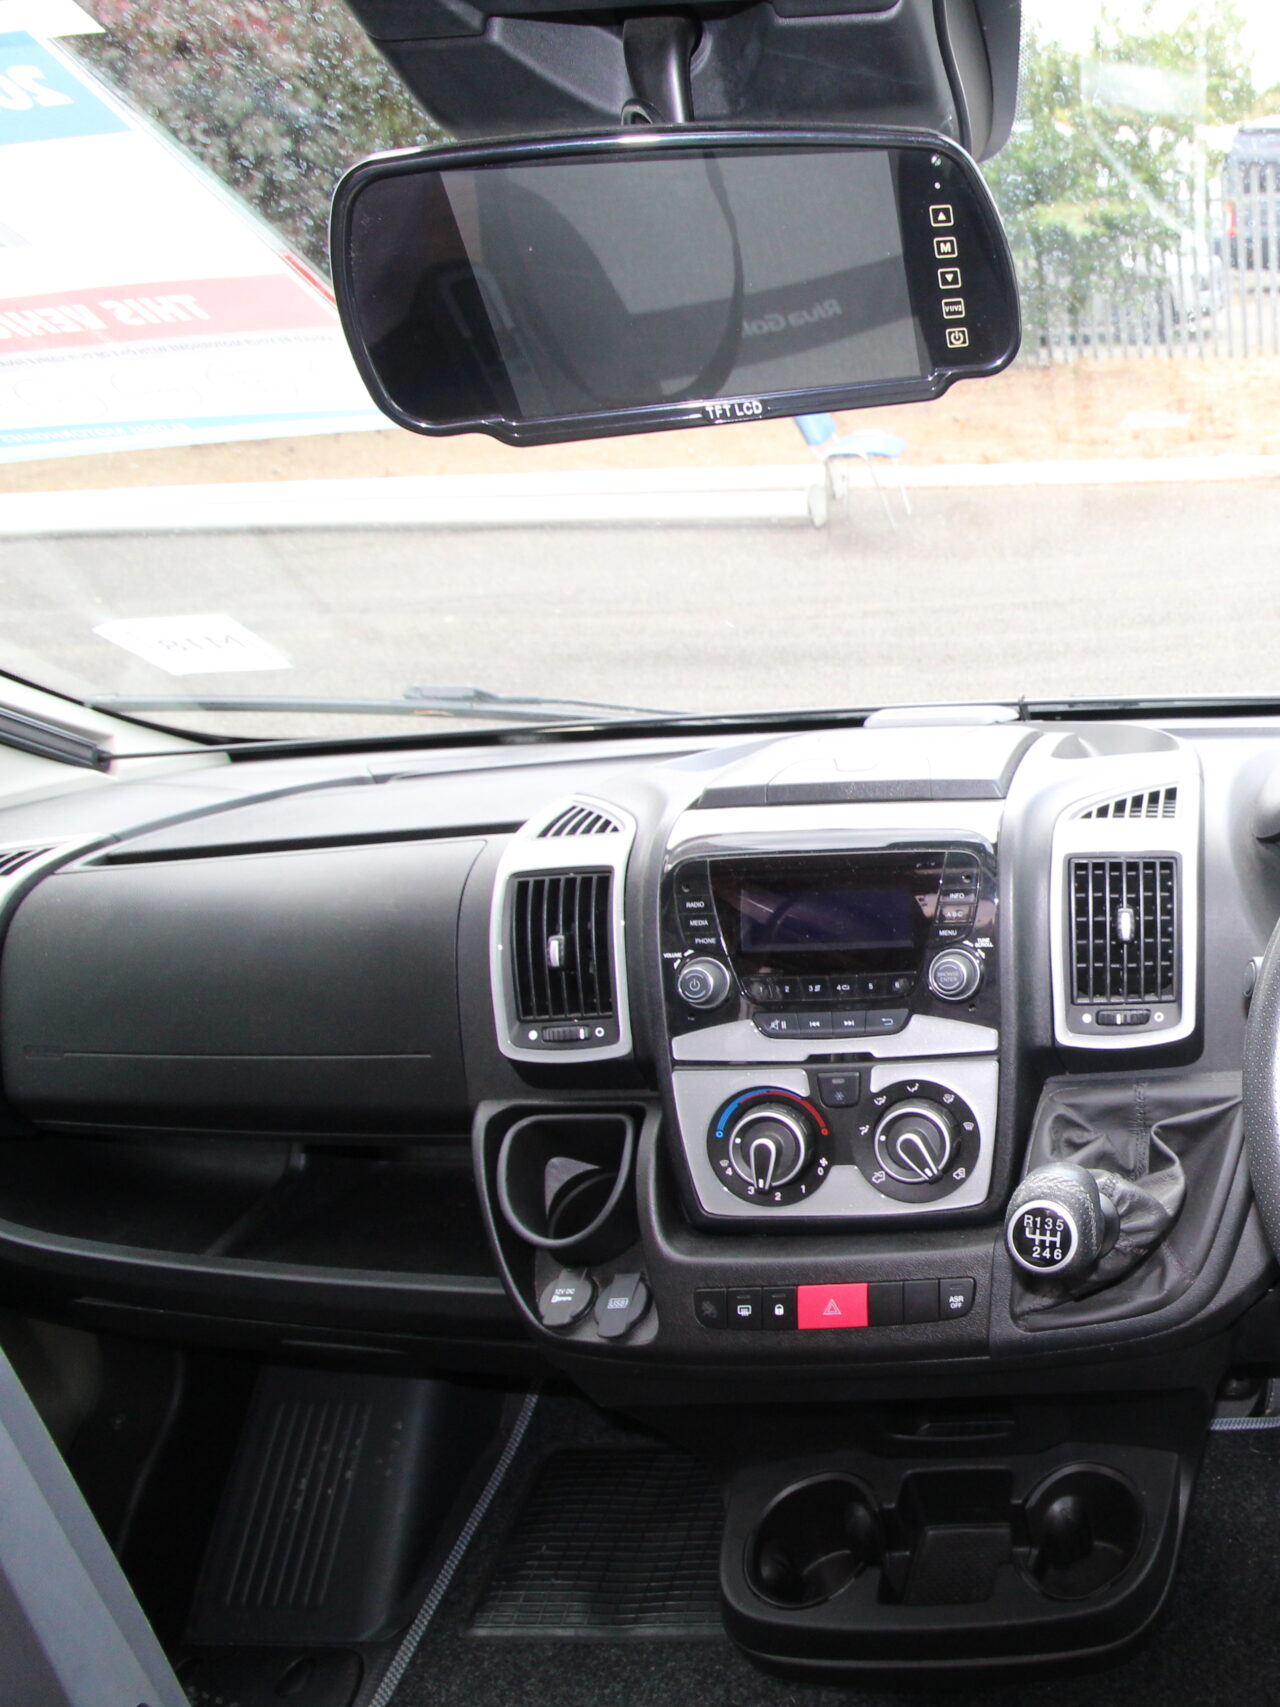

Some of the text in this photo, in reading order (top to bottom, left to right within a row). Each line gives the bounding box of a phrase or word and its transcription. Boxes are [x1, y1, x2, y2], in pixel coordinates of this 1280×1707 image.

[939, 241, 952, 253] M
[705, 401, 763, 420] TFT LCD
[949, 892, 965, 900] INFO
[685, 901, 705, 909] RADIO
[689, 919, 709, 927] MEDIA
[938, 929, 958, 937] MENU
[694, 937, 717, 945] PHONE
[725, 1167, 733, 1177] 4
[747, 1185, 755, 1195] 3
[800, 1184, 806, 1194] 1
[774, 1192, 782, 1201] 2
[949, 1295, 964, 1303] ASR
